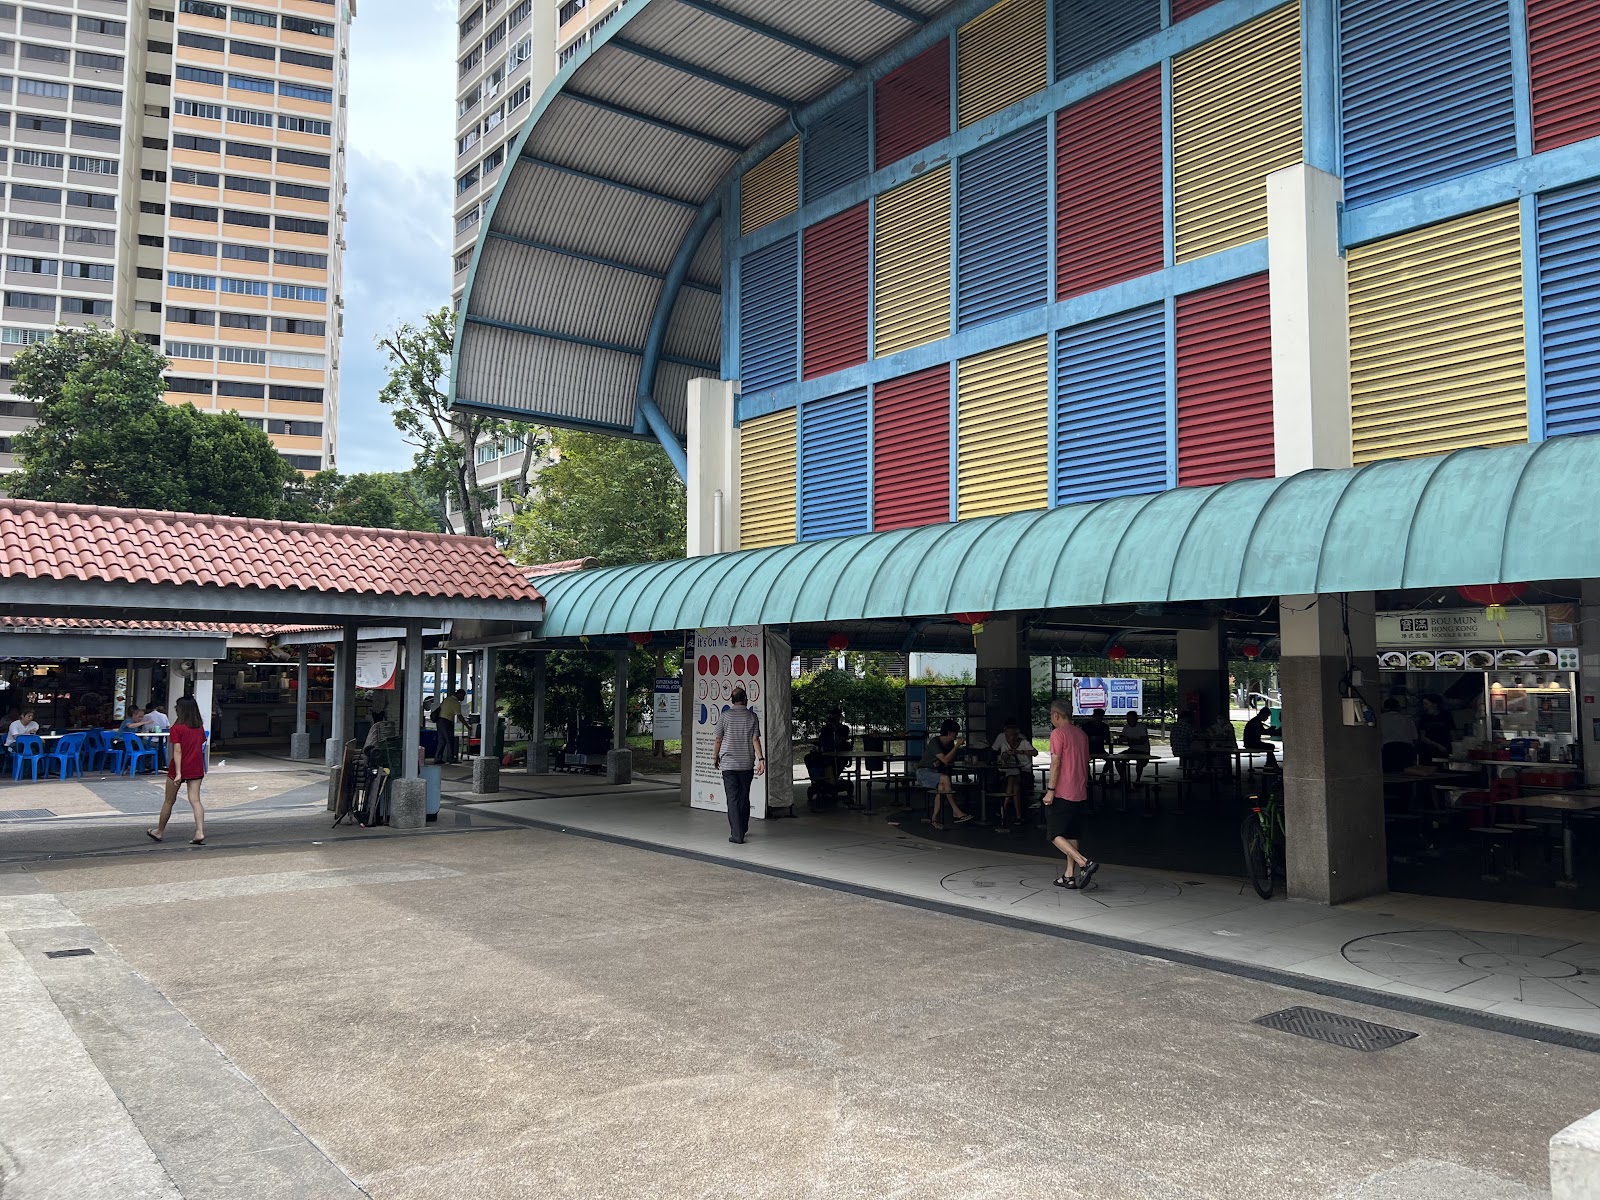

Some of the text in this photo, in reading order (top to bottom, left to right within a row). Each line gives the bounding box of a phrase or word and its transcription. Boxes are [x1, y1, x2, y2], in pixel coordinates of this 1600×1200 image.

[1431, 616, 1477, 625] BOU MUN
[697, 636, 728, 647] It's On Me
